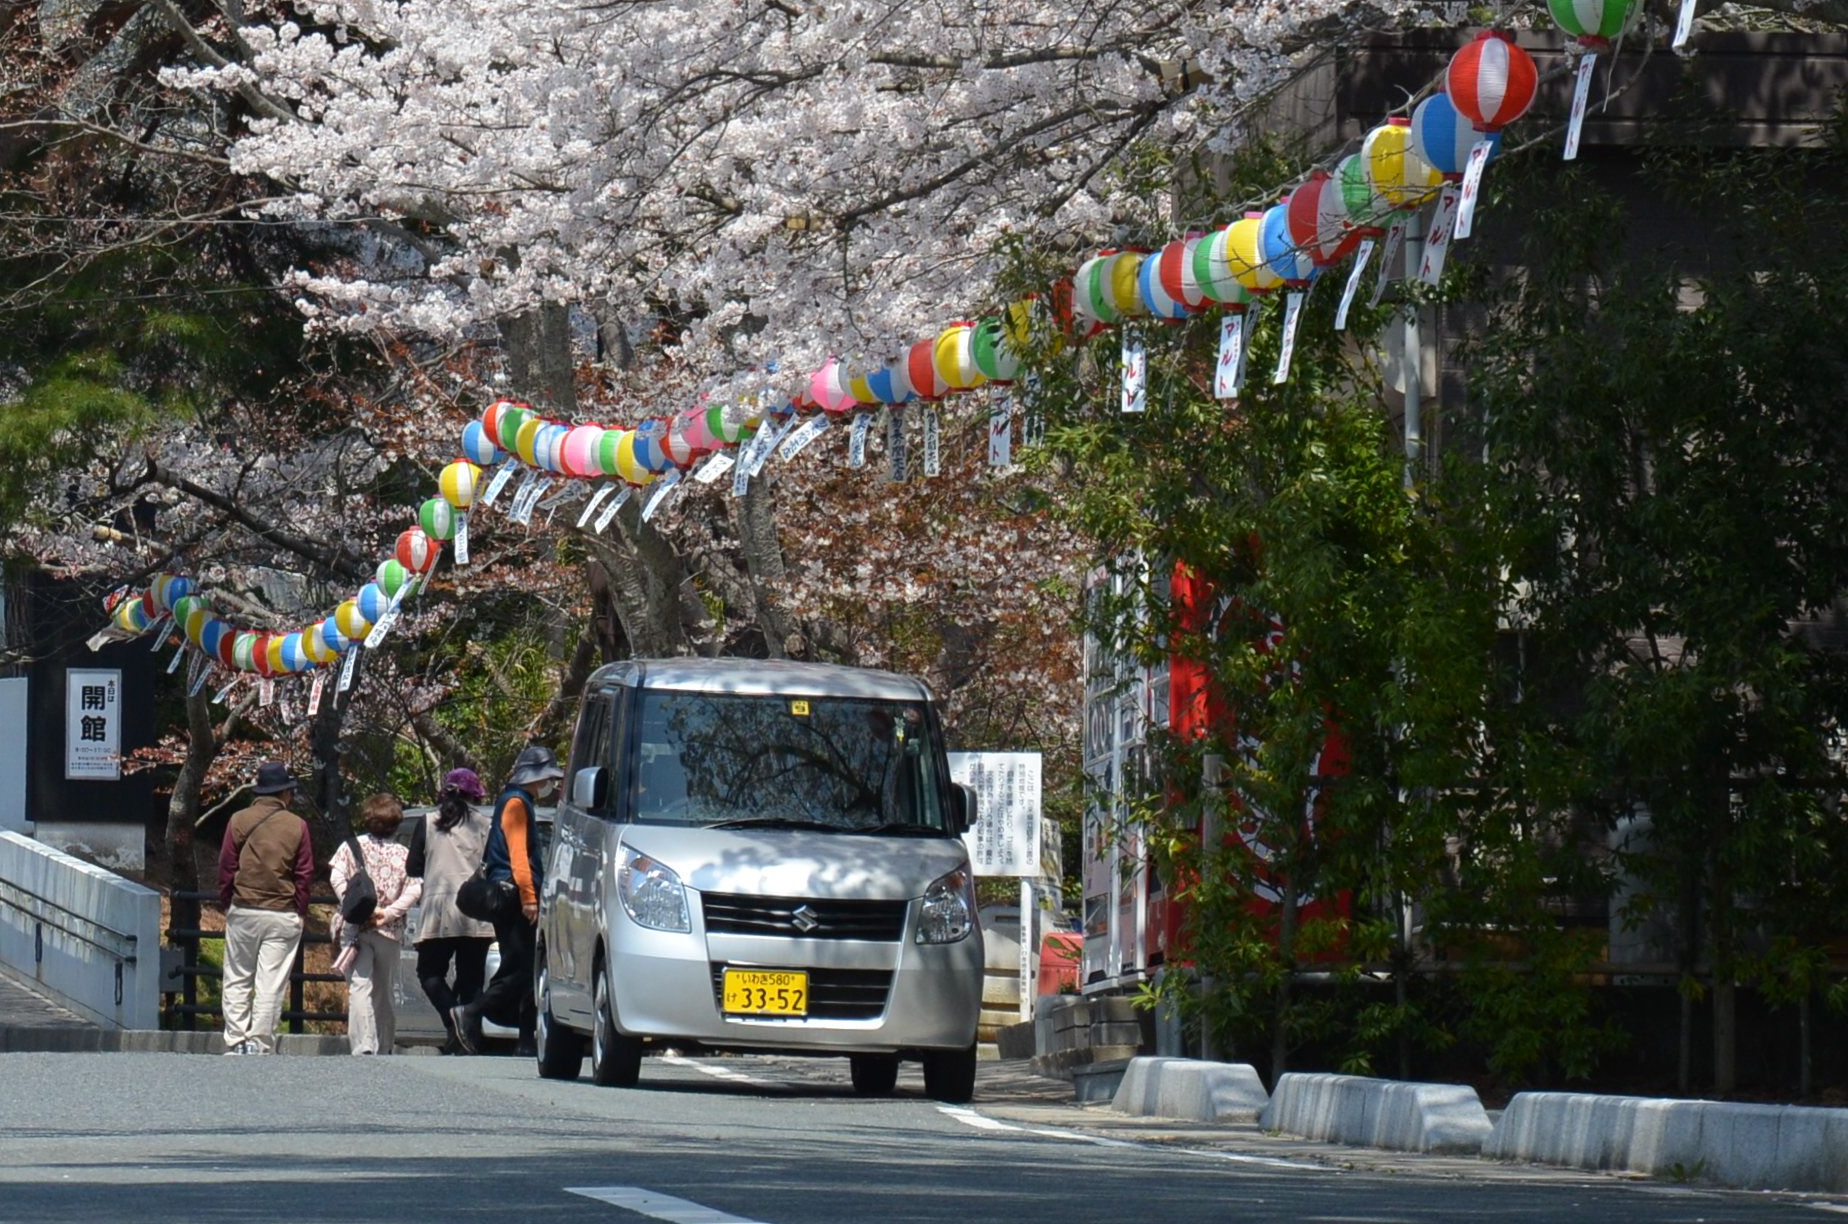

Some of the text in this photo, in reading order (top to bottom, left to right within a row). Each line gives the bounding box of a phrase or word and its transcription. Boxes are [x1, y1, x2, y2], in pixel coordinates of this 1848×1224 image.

[1457, 148, 1482, 234] アルト
[1421, 195, 1455, 278] アルト
[1219, 322, 1236, 395] アルト
[80, 685, 107, 743] 開館
[107, 679, 115, 703] 本日は
[741, 987, 804, 1011] 33-52
